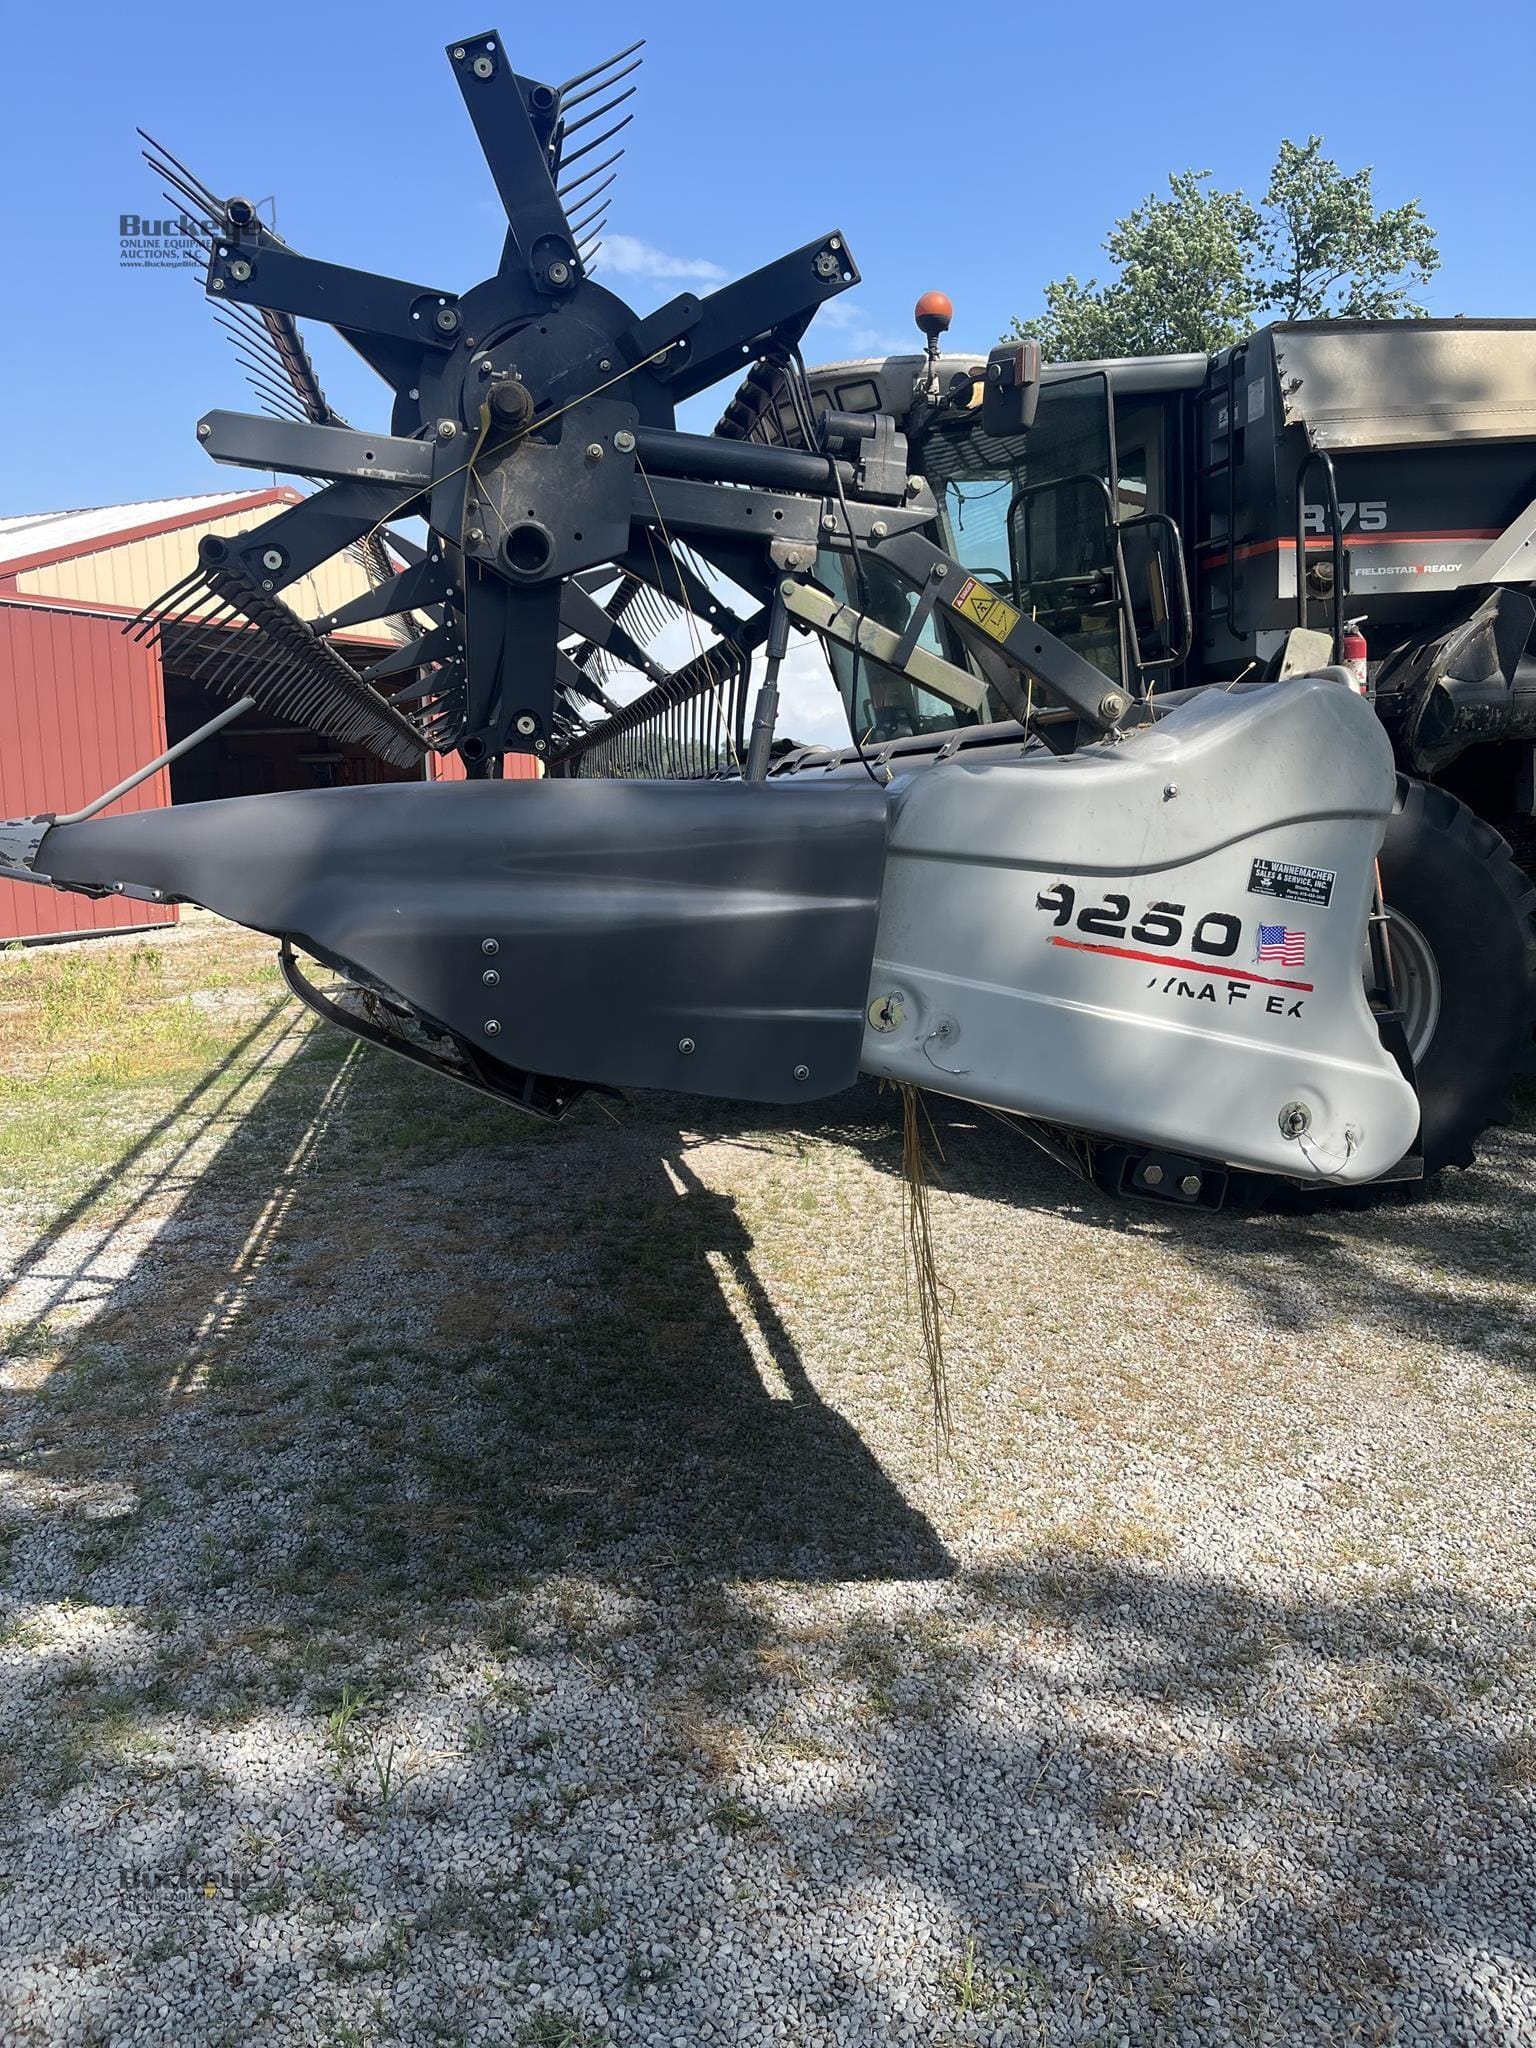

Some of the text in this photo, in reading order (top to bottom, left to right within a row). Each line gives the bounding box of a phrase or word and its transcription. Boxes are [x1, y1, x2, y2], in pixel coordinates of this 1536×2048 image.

[1355, 564, 1462, 576] FIELDSTAR READY
[1255, 869, 1328, 890] SALES & SERVICE, INC.
[1271, 862, 1333, 882] WANNEMACHER
[1036, 883, 1242, 957] 9250
